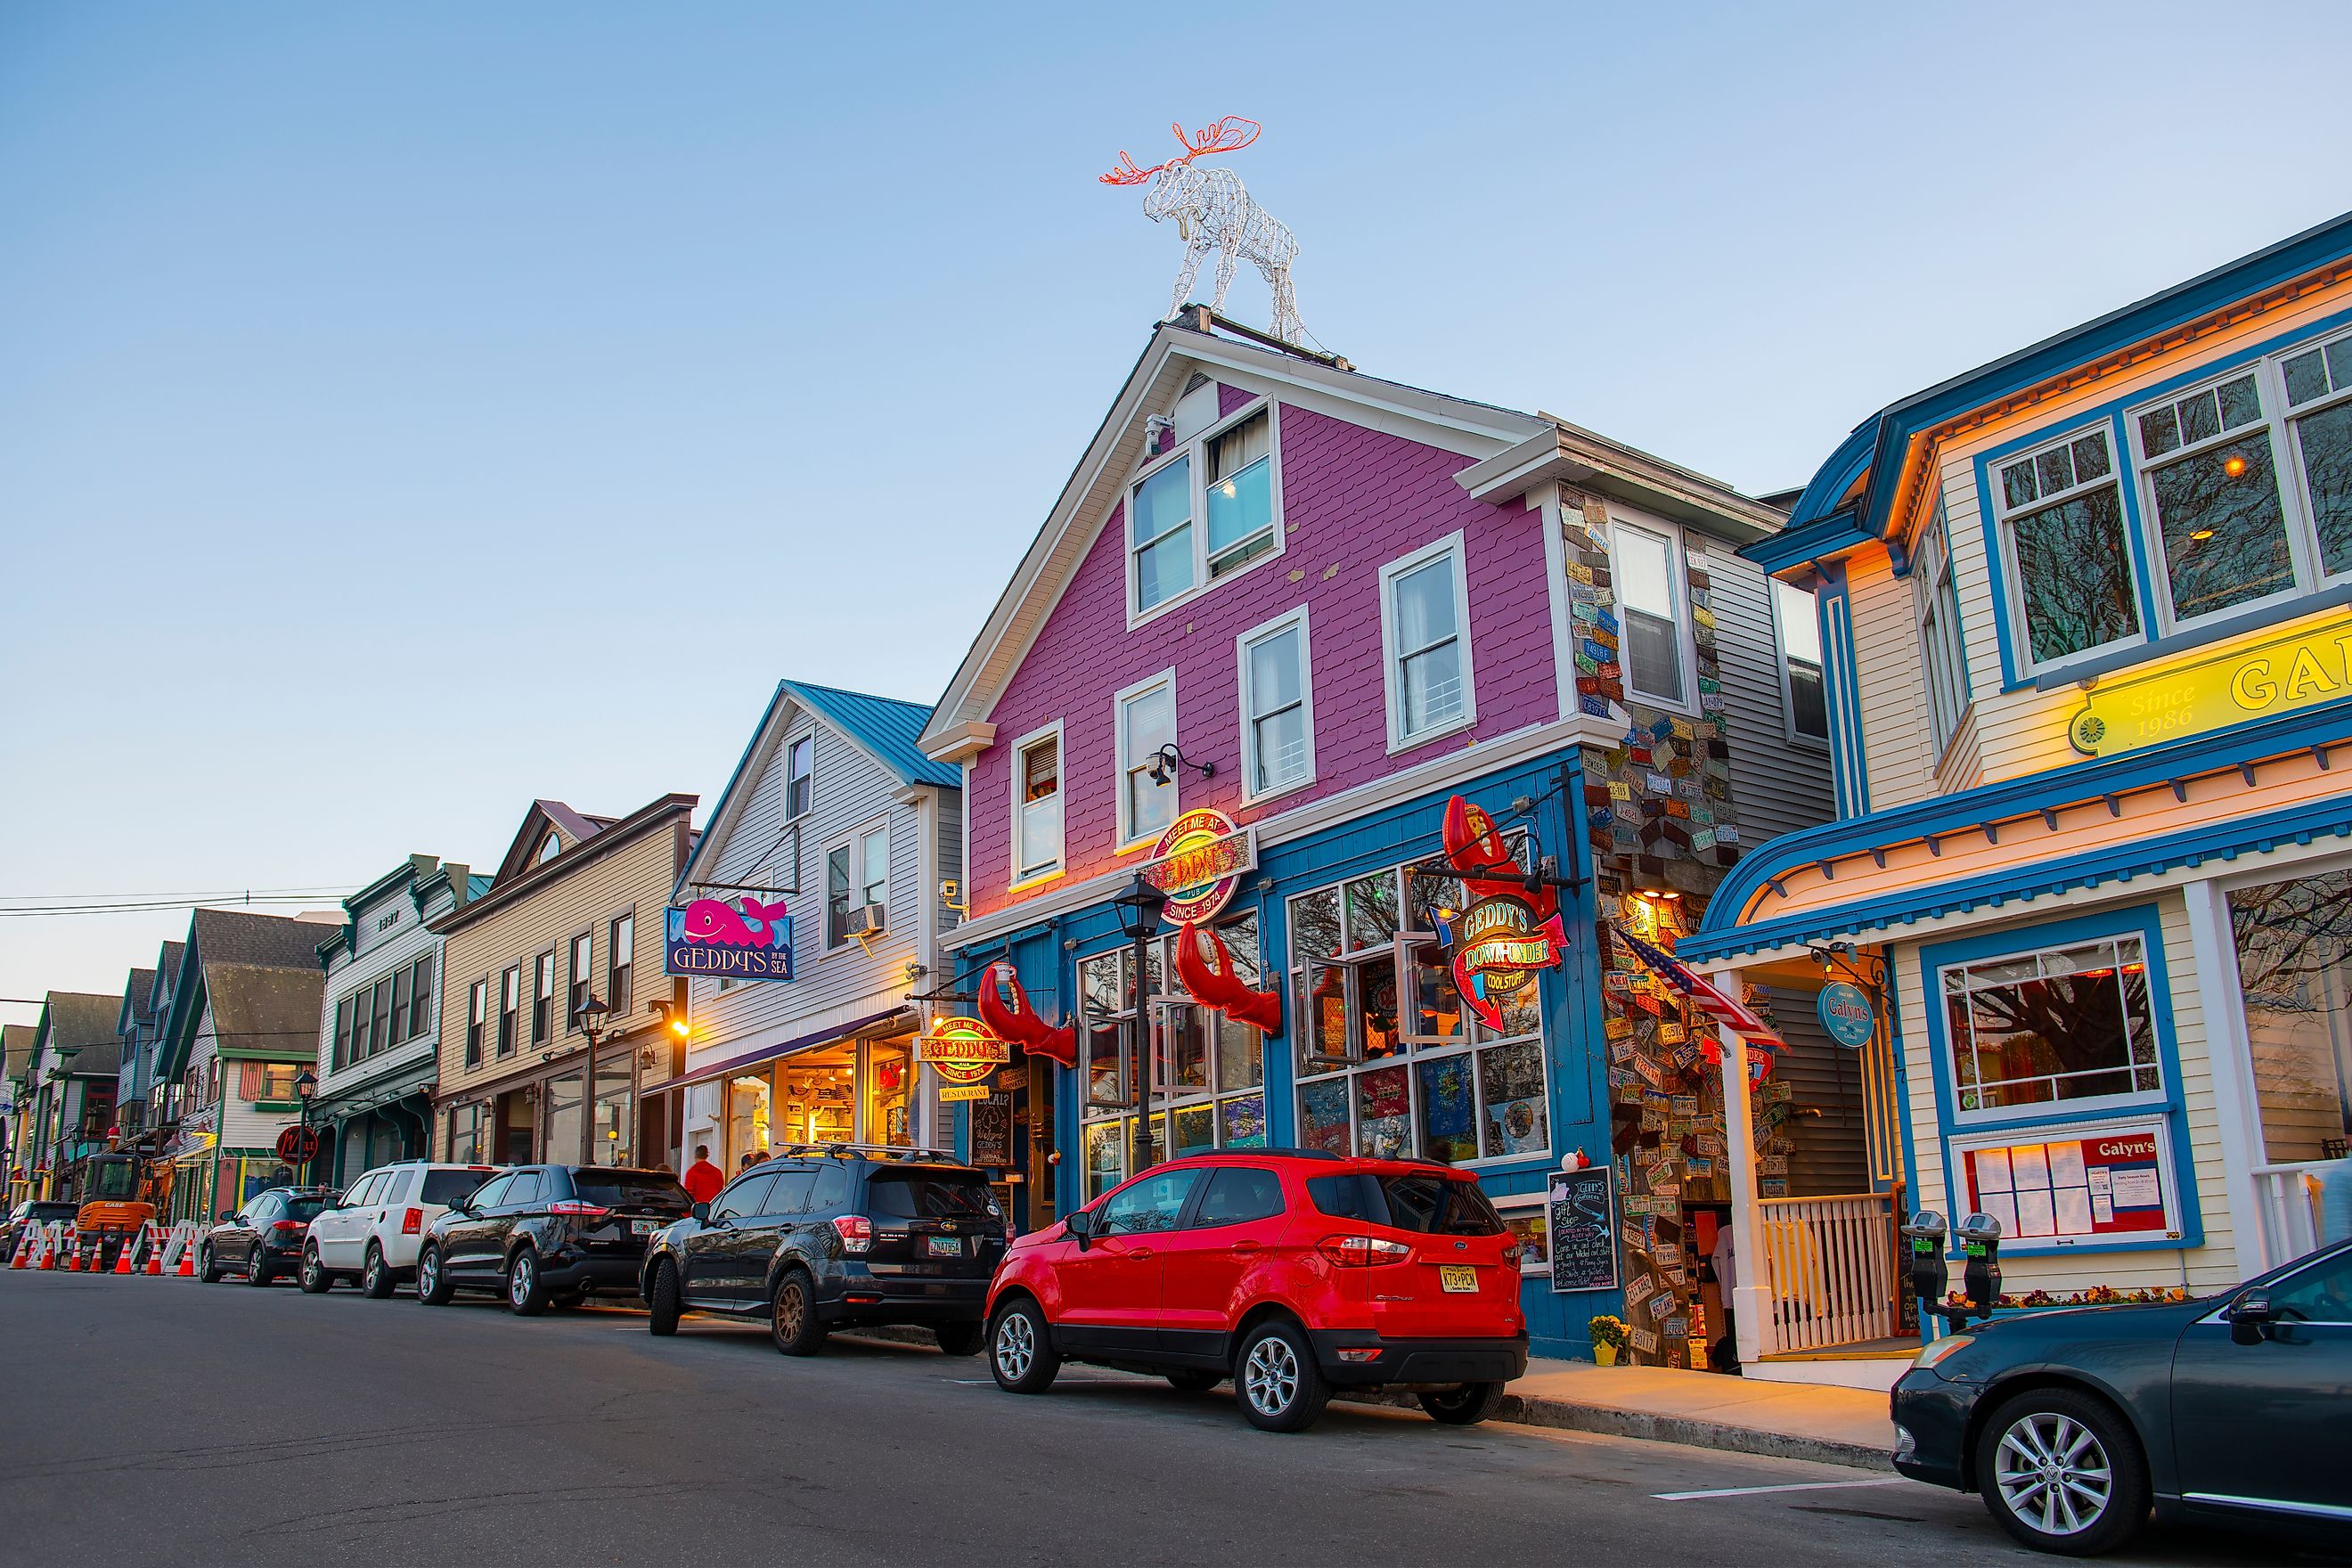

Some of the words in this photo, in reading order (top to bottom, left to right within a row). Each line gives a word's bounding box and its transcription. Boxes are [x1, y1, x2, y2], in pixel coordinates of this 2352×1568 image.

[2130, 685, 2196, 716] Since
[2136, 706, 2193, 739] 1986
[1164, 822, 1188, 845] MEET
[1191, 816, 1205, 829] ME
[1207, 819, 1221, 831] AT
[1187, 889, 1201, 897] PUB
[1170, 904, 1196, 919] SINCE
[1202, 891, 1221, 913] 1974
[378, 911, 399, 932] 1887
[1465, 902, 1528, 942] GEDDY'S
[674, 947, 767, 973] GEDDY'S
[779, 952, 787, 960] THE
[771, 960, 788, 974] SEA
[1487, 975, 1503, 990] COOL
[942, 1022, 961, 1033] MEET
[963, 1021, 974, 1030] ME
[944, 1067, 967, 1079] SINCE
[969, 1068, 984, 1078] 1974
[1001, 1079, 1025, 1090] PRIVATE
[942, 1089, 987, 1098] RESTAURANT
[976, 1140, 1002, 1149] GEDDY'S
[2099, 1141, 2156, 1157] Galyn's
[1555, 1202, 1571, 1221] gift
[1558, 1228, 1577, 1237] LOCATED
[1556, 1243, 1571, 1254] Come
[1591, 1237, 1606, 1248] check
[1555, 1253, 1564, 1262] out
